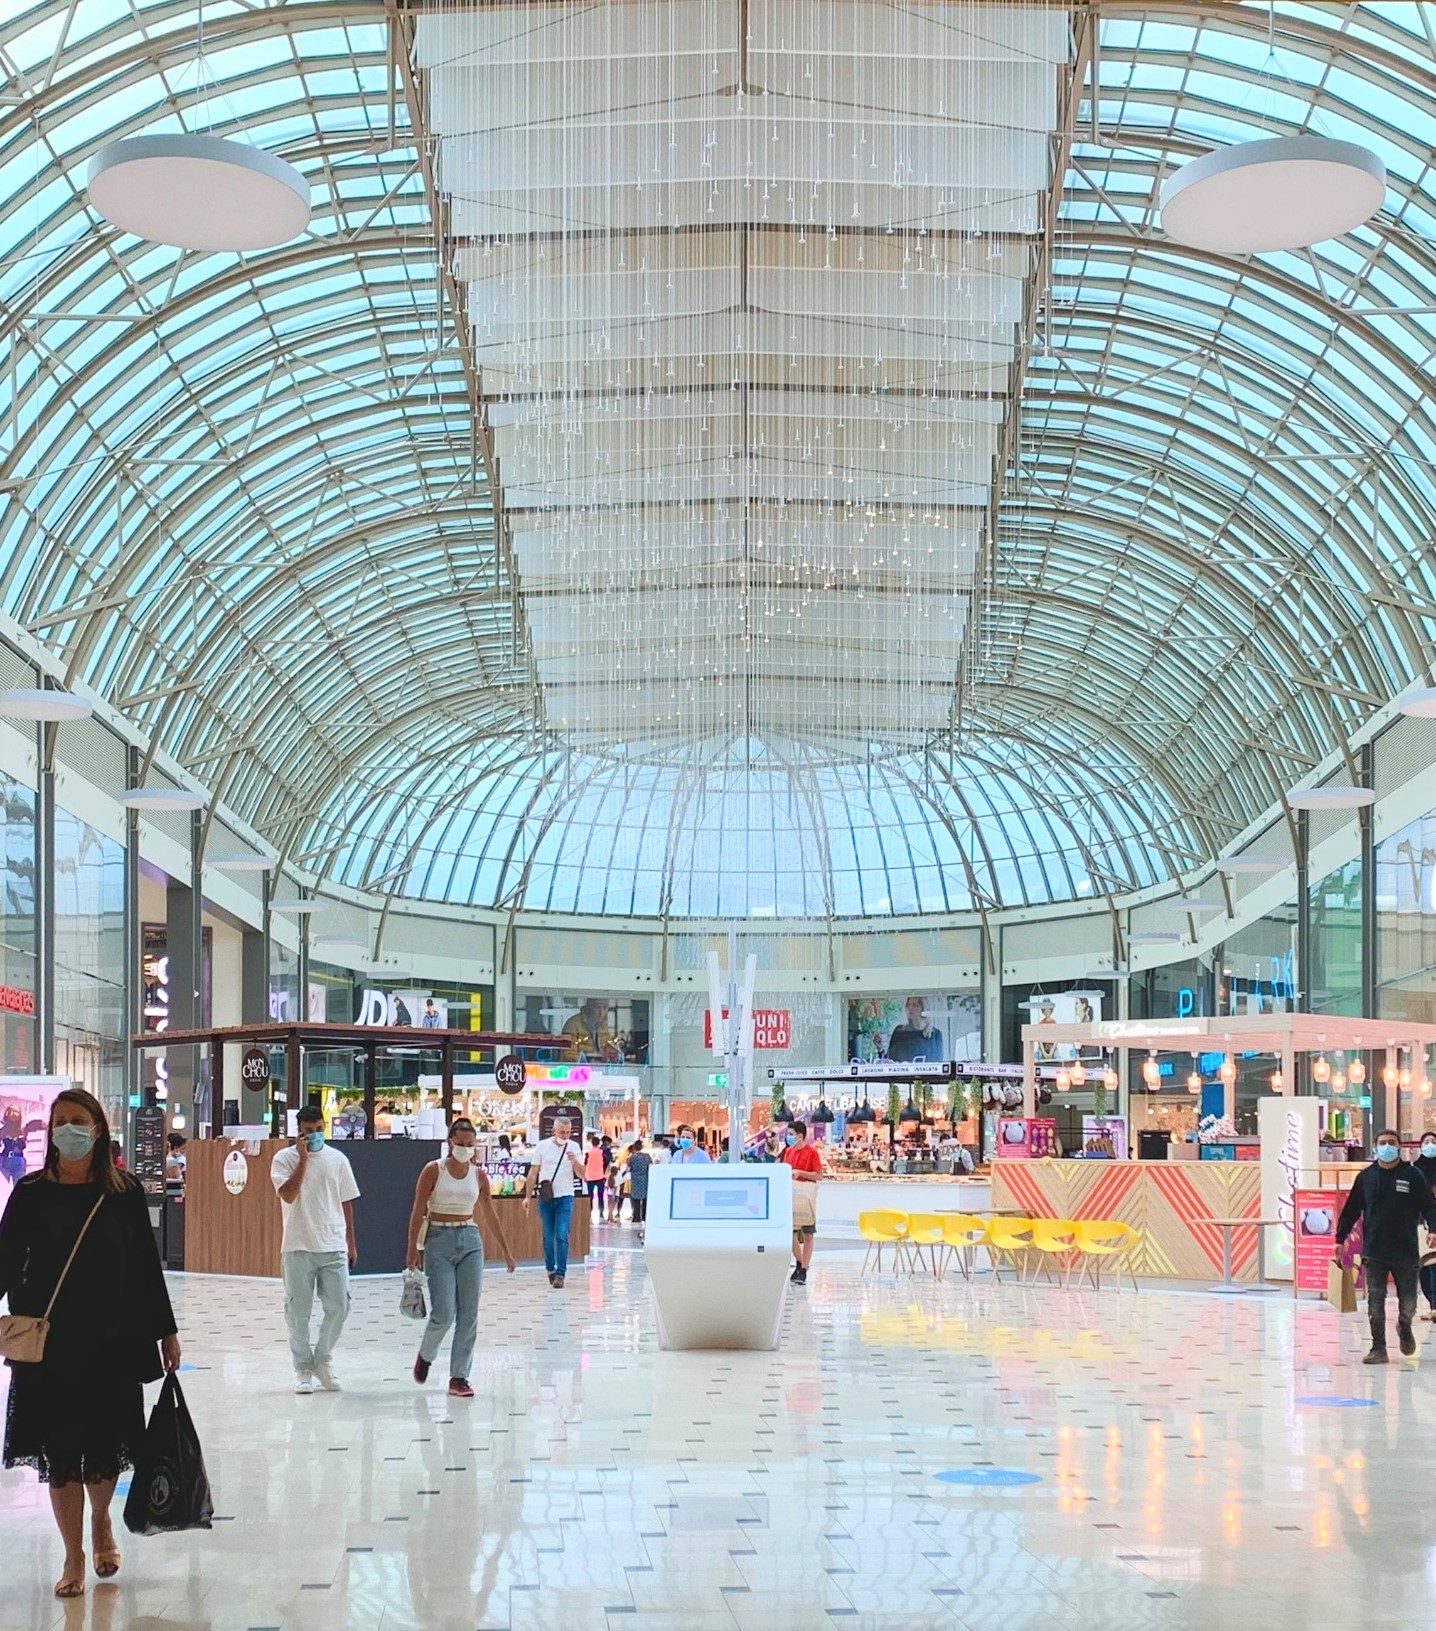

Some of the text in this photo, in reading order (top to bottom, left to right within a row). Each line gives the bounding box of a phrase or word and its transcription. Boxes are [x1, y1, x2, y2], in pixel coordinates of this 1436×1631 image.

[354, 989, 388, 1026] JD
[756, 1014, 784, 1028] UNI
[756, 1030, 787, 1046] QLO
[247, 1058, 265, 1068] MON
[503, 1062, 522, 1072] MON
[242, 1064, 269, 1078] CHOU
[497, 1068, 527, 1082] CHOU
[507, 1164, 526, 1174] tea
